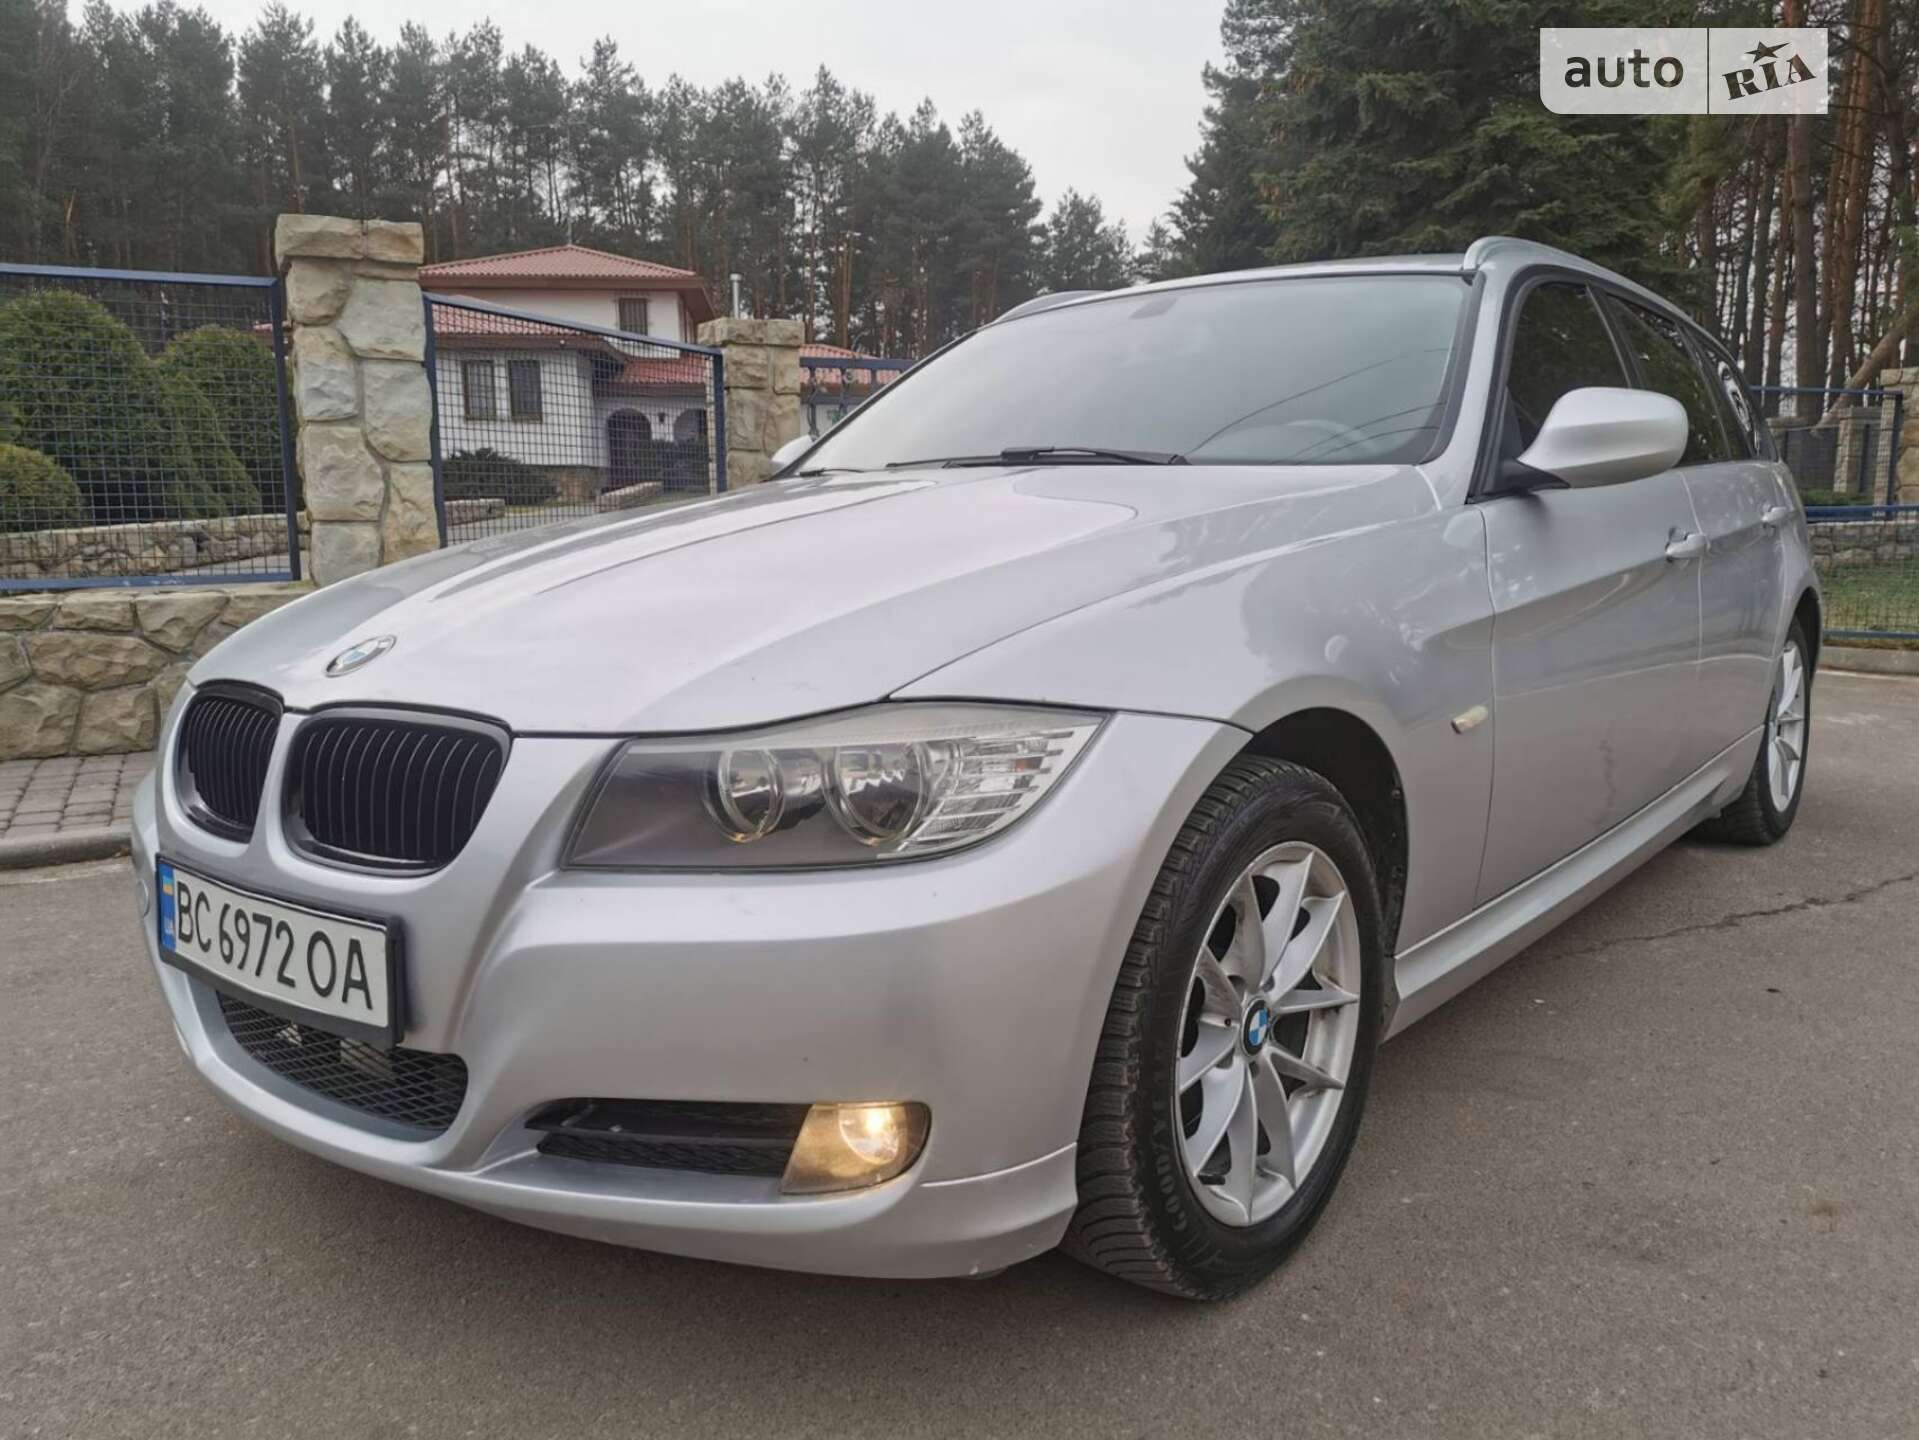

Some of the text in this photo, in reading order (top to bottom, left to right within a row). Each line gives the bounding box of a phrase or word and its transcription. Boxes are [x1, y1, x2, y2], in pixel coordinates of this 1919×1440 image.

[177, 880, 373, 1011] BC 6972 OA
